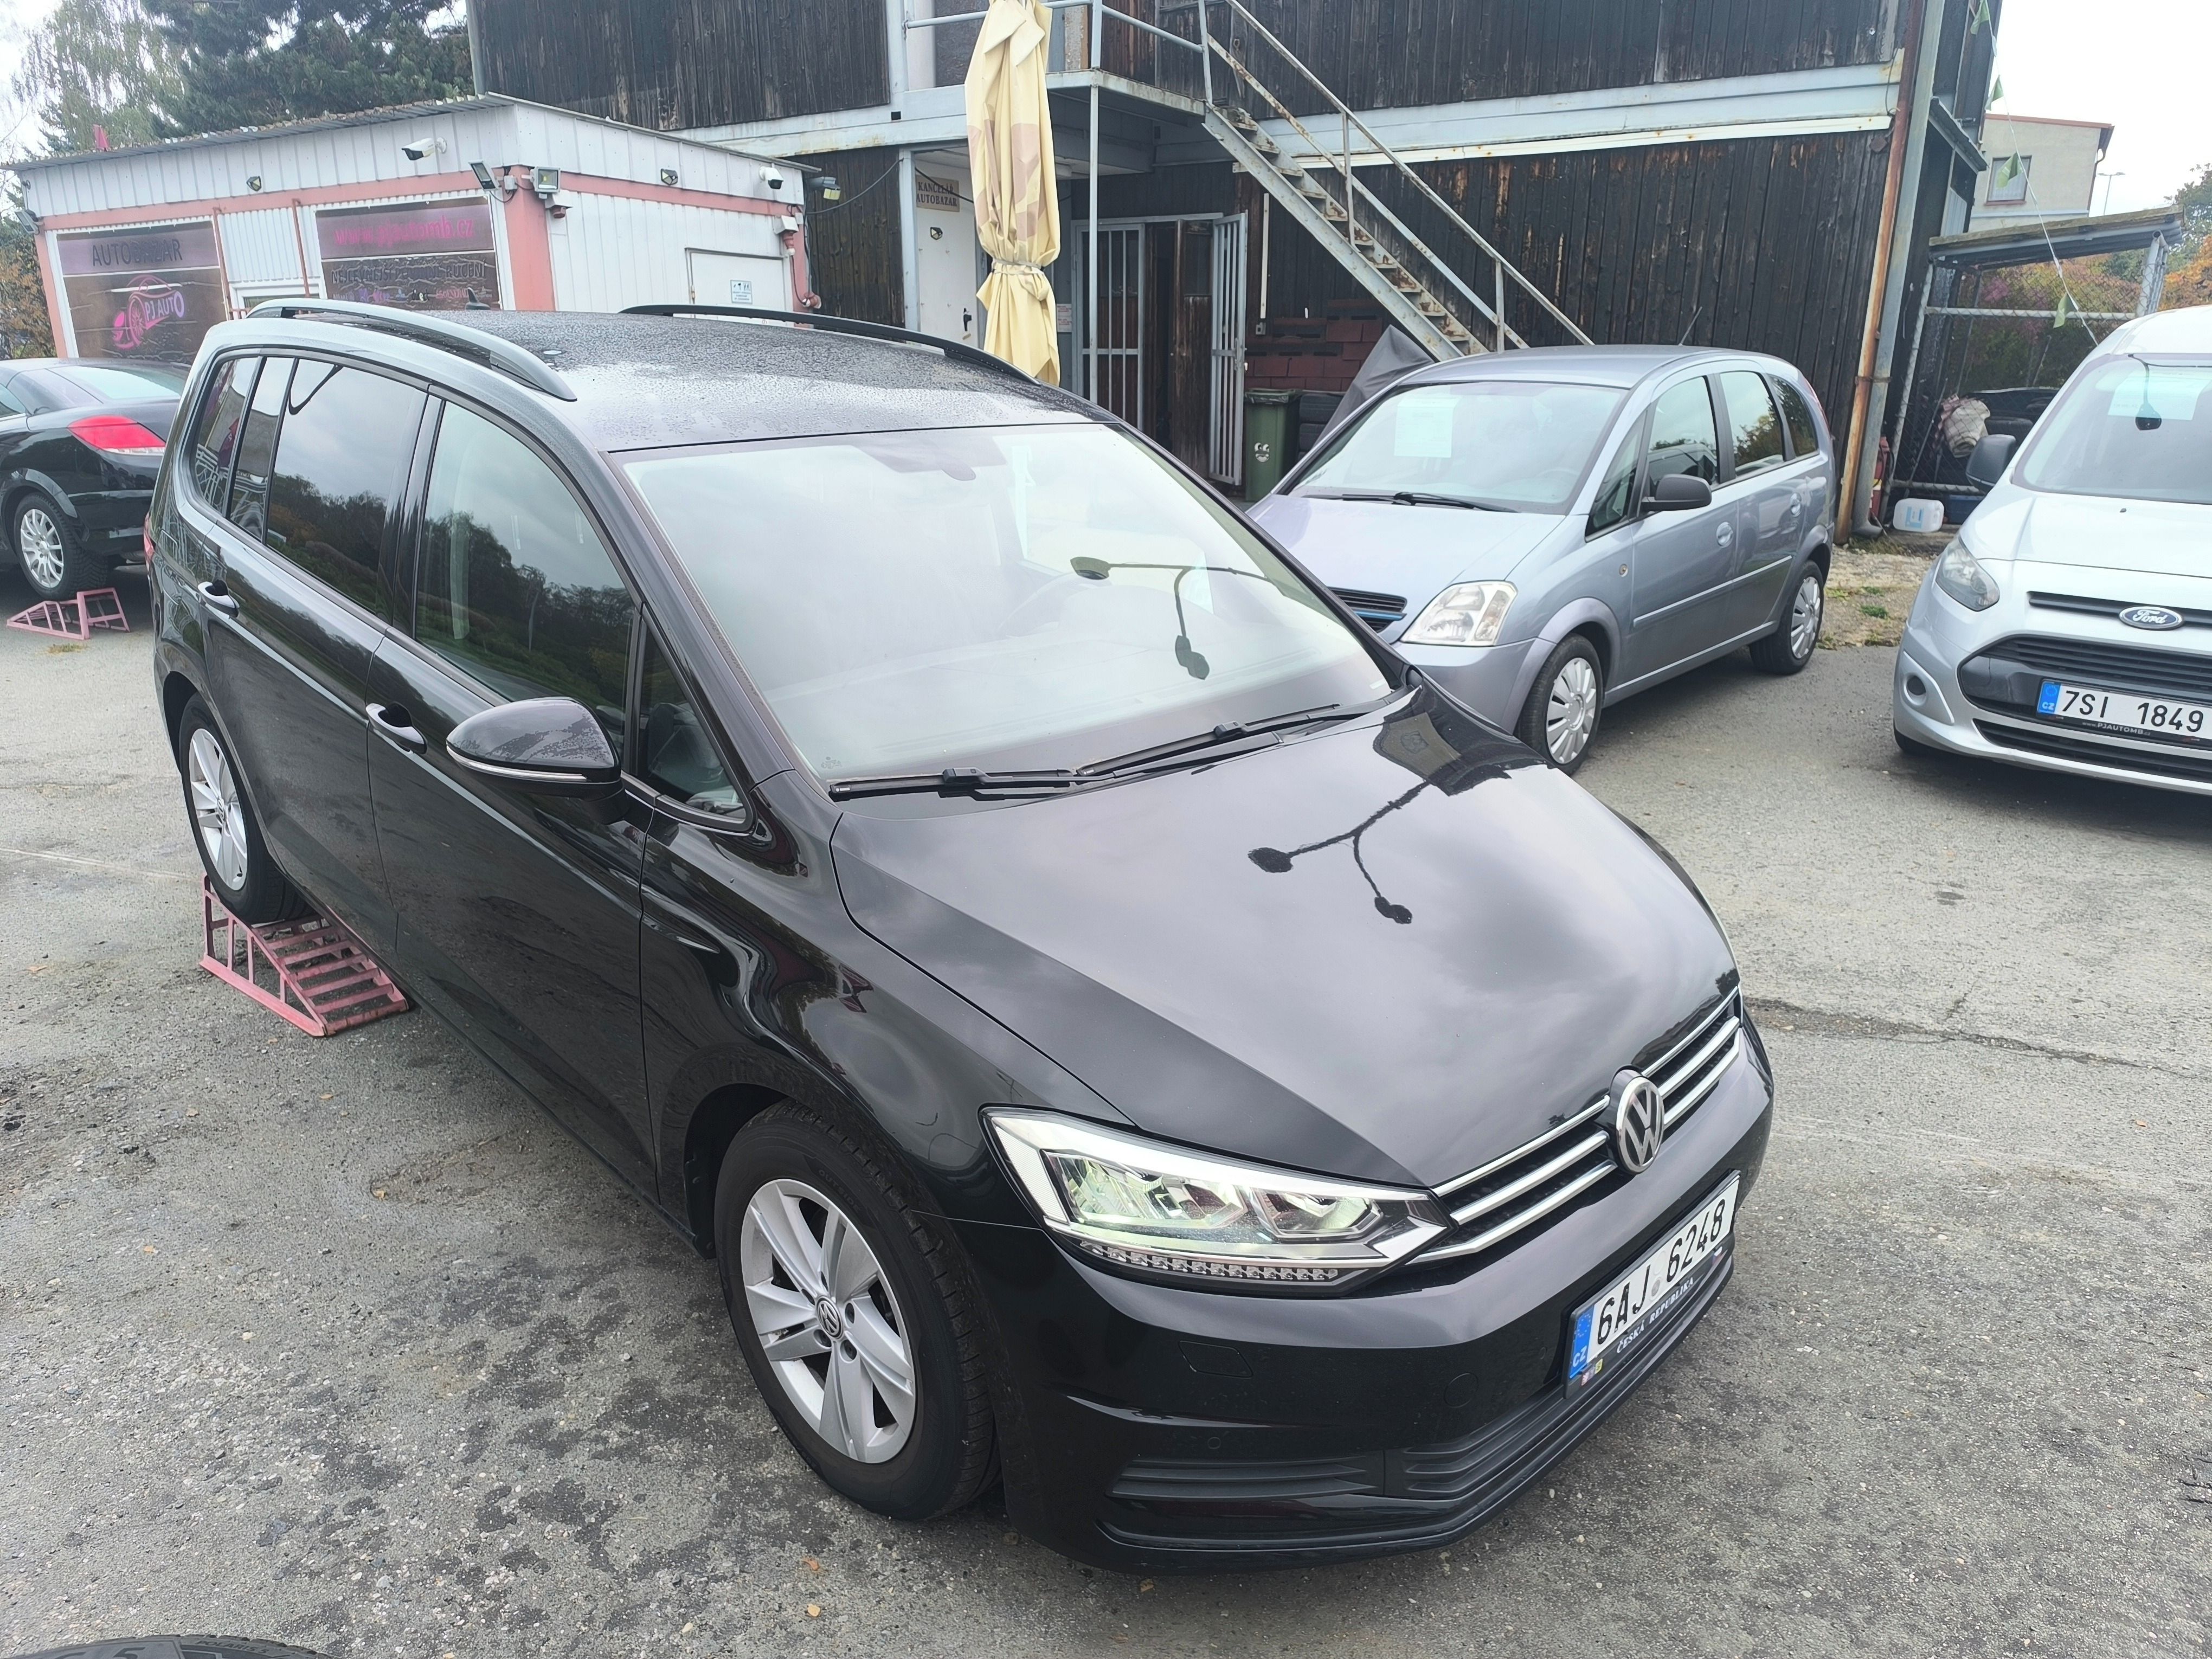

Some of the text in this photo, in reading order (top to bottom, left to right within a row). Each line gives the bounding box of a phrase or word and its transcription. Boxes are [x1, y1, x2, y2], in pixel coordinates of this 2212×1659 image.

[916, 193, 957, 206] AUTOBAZAR
[93, 239, 183, 266] AUTOBAZAR
[158, 291, 184, 318] AUTO
[2132, 609, 2168, 623] Ford
[2042, 690, 2204, 732] CZ 7SI 1849
[1573, 1198, 1725, 1367] CZ 6AJ 6248
[1617, 1277, 1693, 1353] ČESKÁ REPUBLIKA
[195, 1640, 259, 1651] POLARIS
